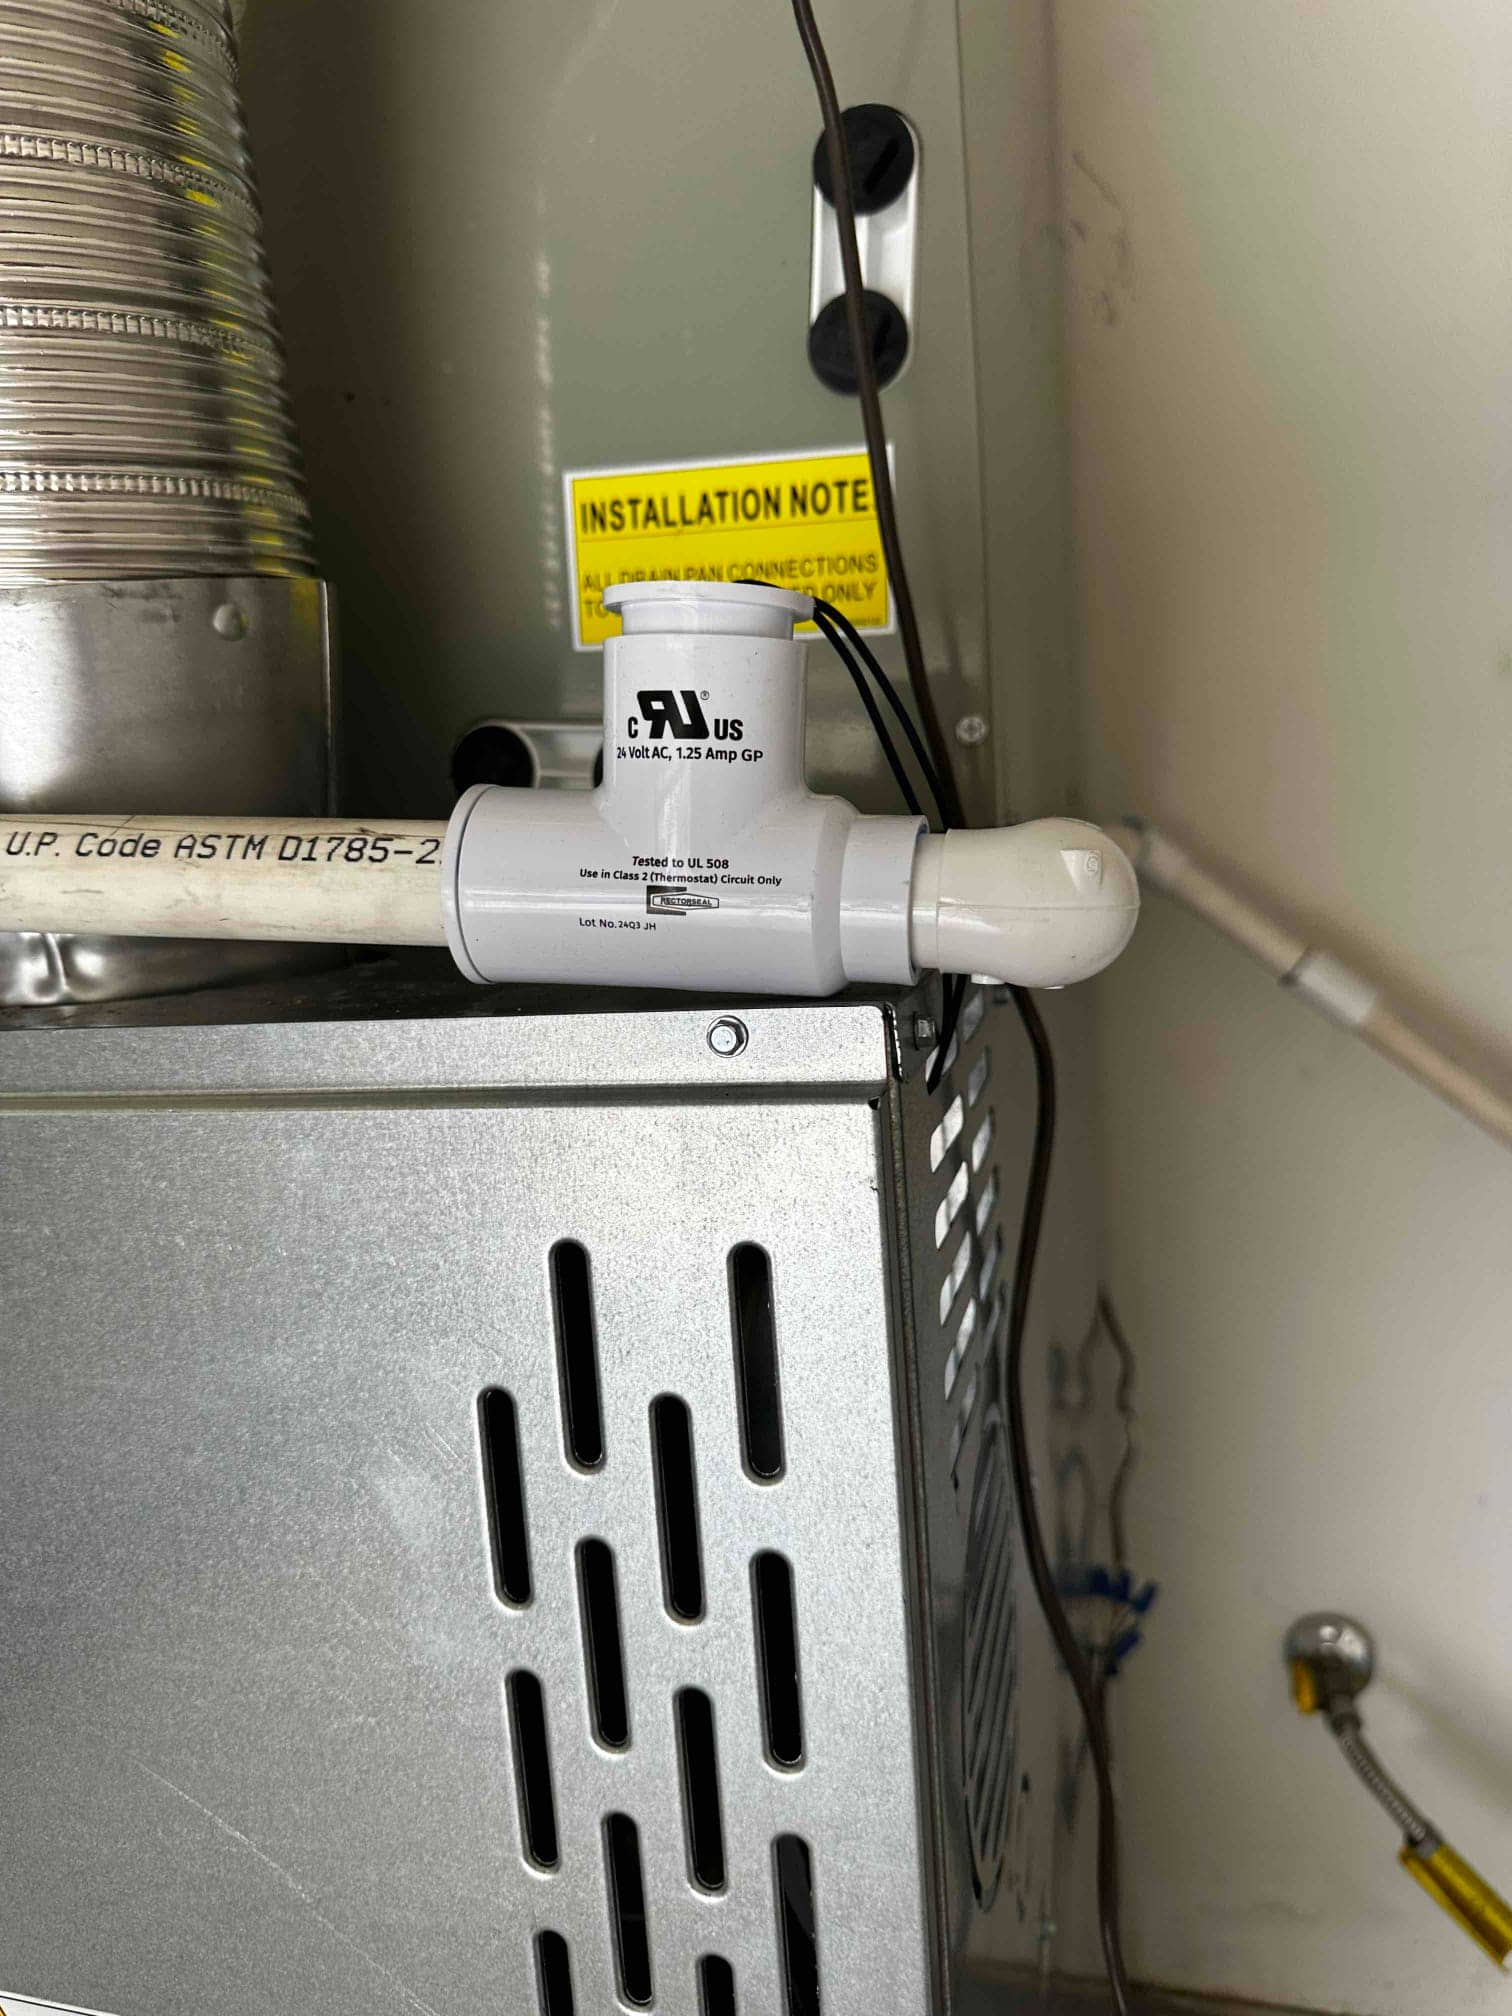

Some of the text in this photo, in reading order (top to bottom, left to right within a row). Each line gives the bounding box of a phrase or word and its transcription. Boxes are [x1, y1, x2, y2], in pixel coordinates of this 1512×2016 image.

[581, 486, 781, 534] INSTALLATION
[727, 552, 877, 583] CONNECTIONS
[821, 581, 878, 603] ONLY
[713, 718, 744, 742] US
[616, 745, 764, 764] 24 Volt AC, 1.25 Amp GP
[5, 831, 443, 865] U.P. Code ASTM D1785-2
[631, 855, 730, 870] Tested to UL 508
[579, 868, 783, 887] Use in Class 2 (Thermostat) Circuit Only
[579, 917, 597, 928] Lot
[643, 922, 657, 931] JH
